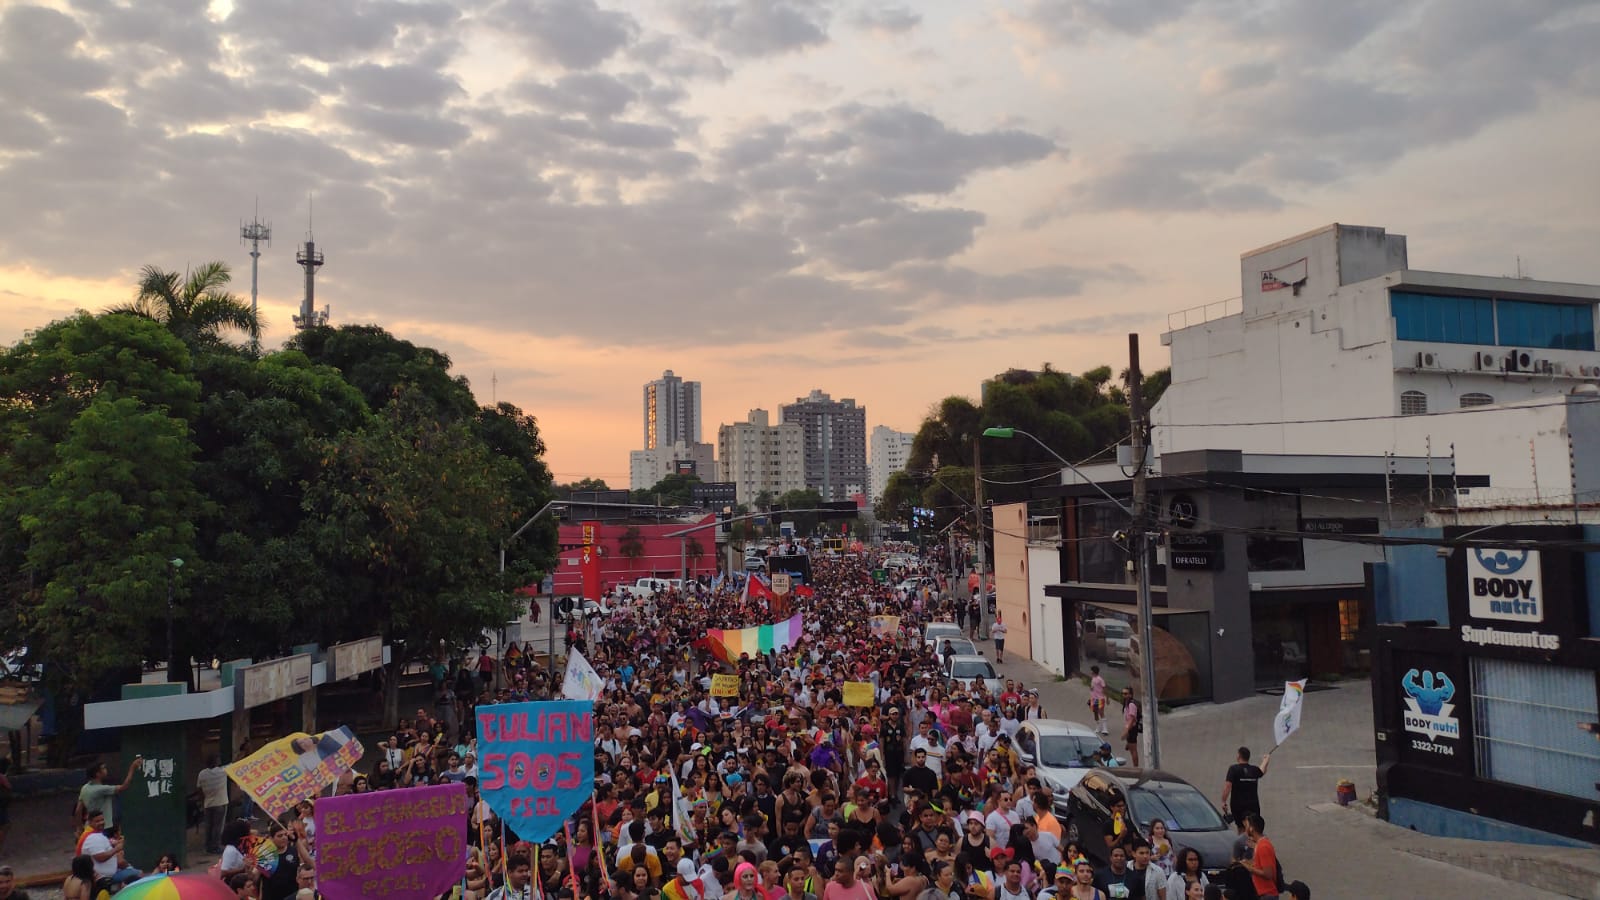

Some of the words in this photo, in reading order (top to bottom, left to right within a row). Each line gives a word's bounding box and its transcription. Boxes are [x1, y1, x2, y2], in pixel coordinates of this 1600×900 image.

[1473, 577, 1533, 599] BODY
[1490, 597, 1537, 615] nutri
[1461, 624, 1560, 650] Suplementos
[1406, 716, 1431, 730] BODY
[1432, 721, 1458, 734] nutri
[1411, 739, 1455, 756] 3322-7784
[482, 751, 582, 791] 5005
[510, 795, 561, 817] PSOL
[319, 825, 461, 883] 50050
